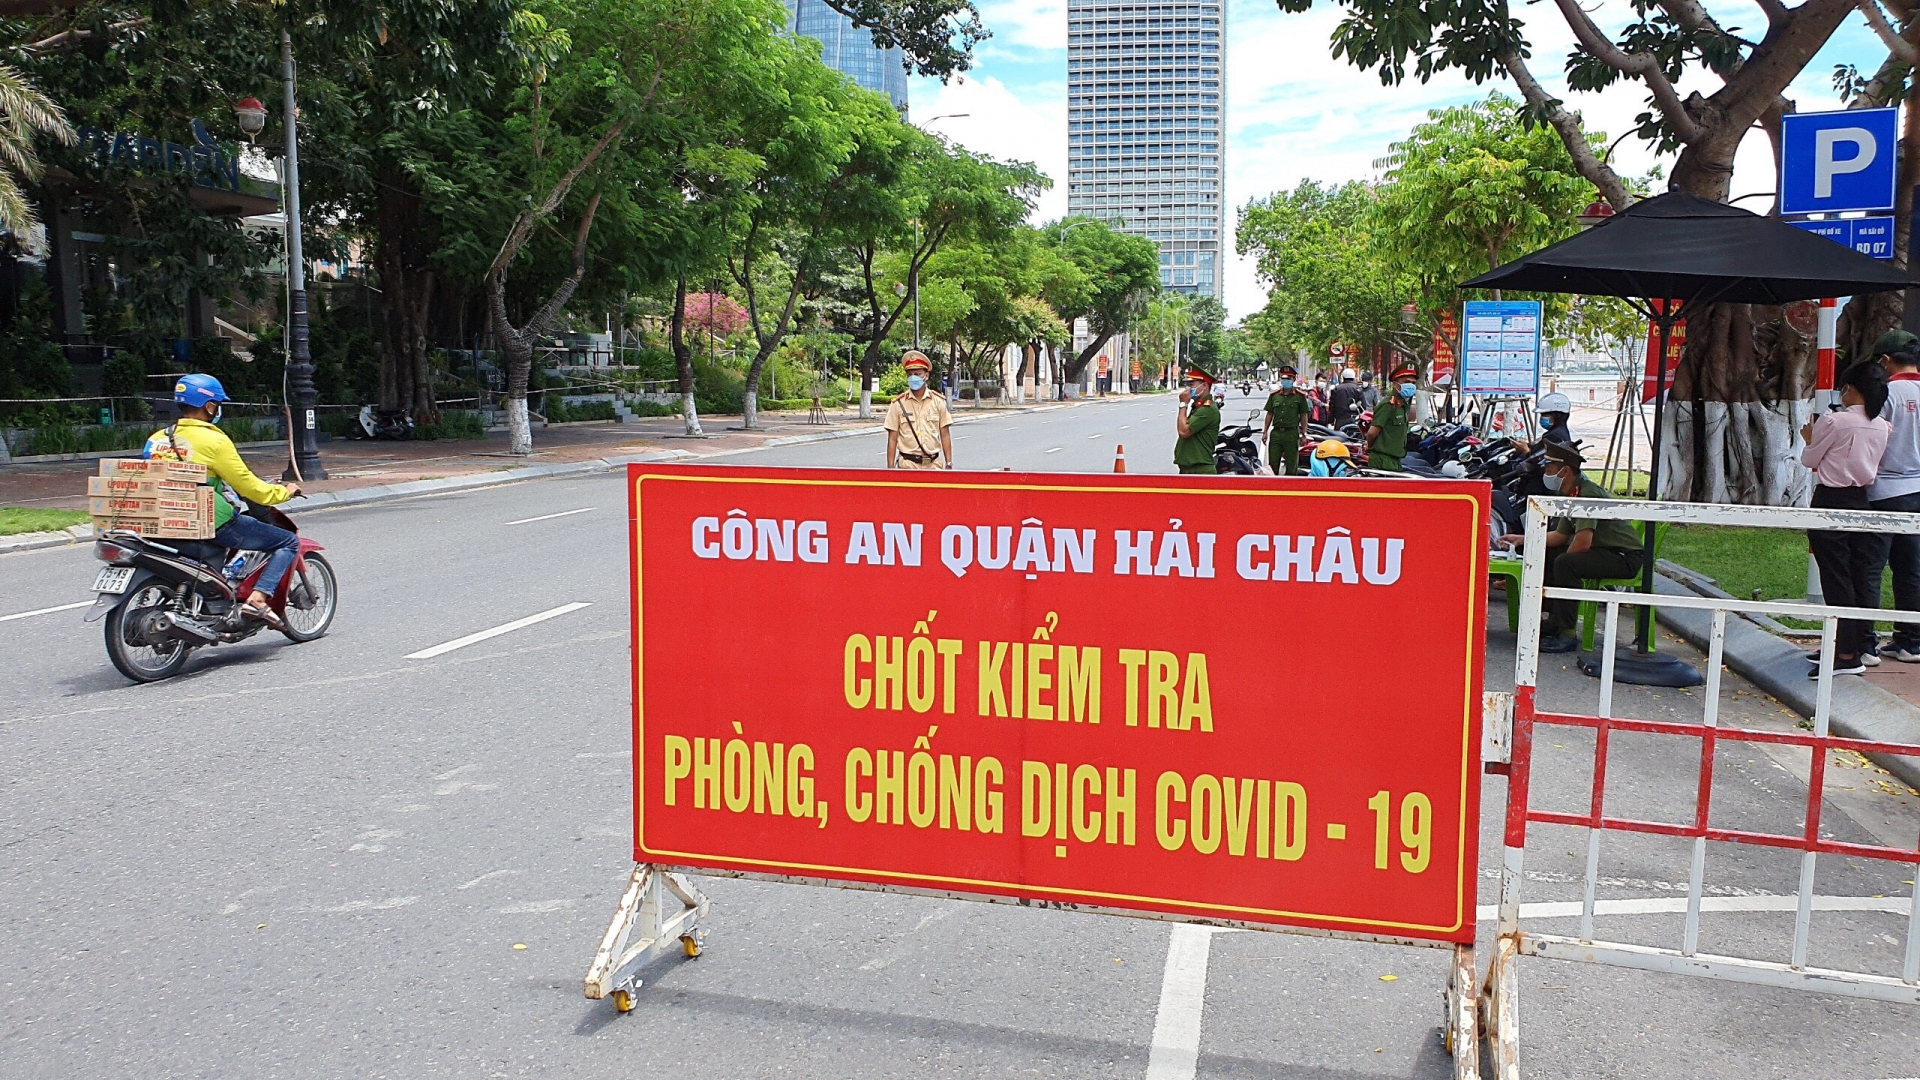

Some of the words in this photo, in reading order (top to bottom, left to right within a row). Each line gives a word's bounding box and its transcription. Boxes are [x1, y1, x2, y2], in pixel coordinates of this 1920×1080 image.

[1814, 127, 1877, 199] P
[1873, 242, 1887, 254] 07
[118, 461, 148, 471] LIPOVITAN
[691, 508, 829, 565] CÔNG
[844, 521, 924, 567] AN
[940, 517, 1097, 580] QUẬN
[1113, 518, 1217, 579] HẢI
[1235, 525, 1405, 586] CHÂU
[843, 609, 963, 714] CHỐT
[978, 609, 1102, 724] KIỂM
[1118, 648, 1214, 733] TRA
[664, 719, 829, 829] PHÒNG,
[844, 725, 1004, 835] CHỐNG
[1021, 760, 1137, 858] DỊCH
[1155, 770, 1308, 862] COVID
[1327, 822, 1347, 840] -
[1367, 790, 1432, 874] 19
